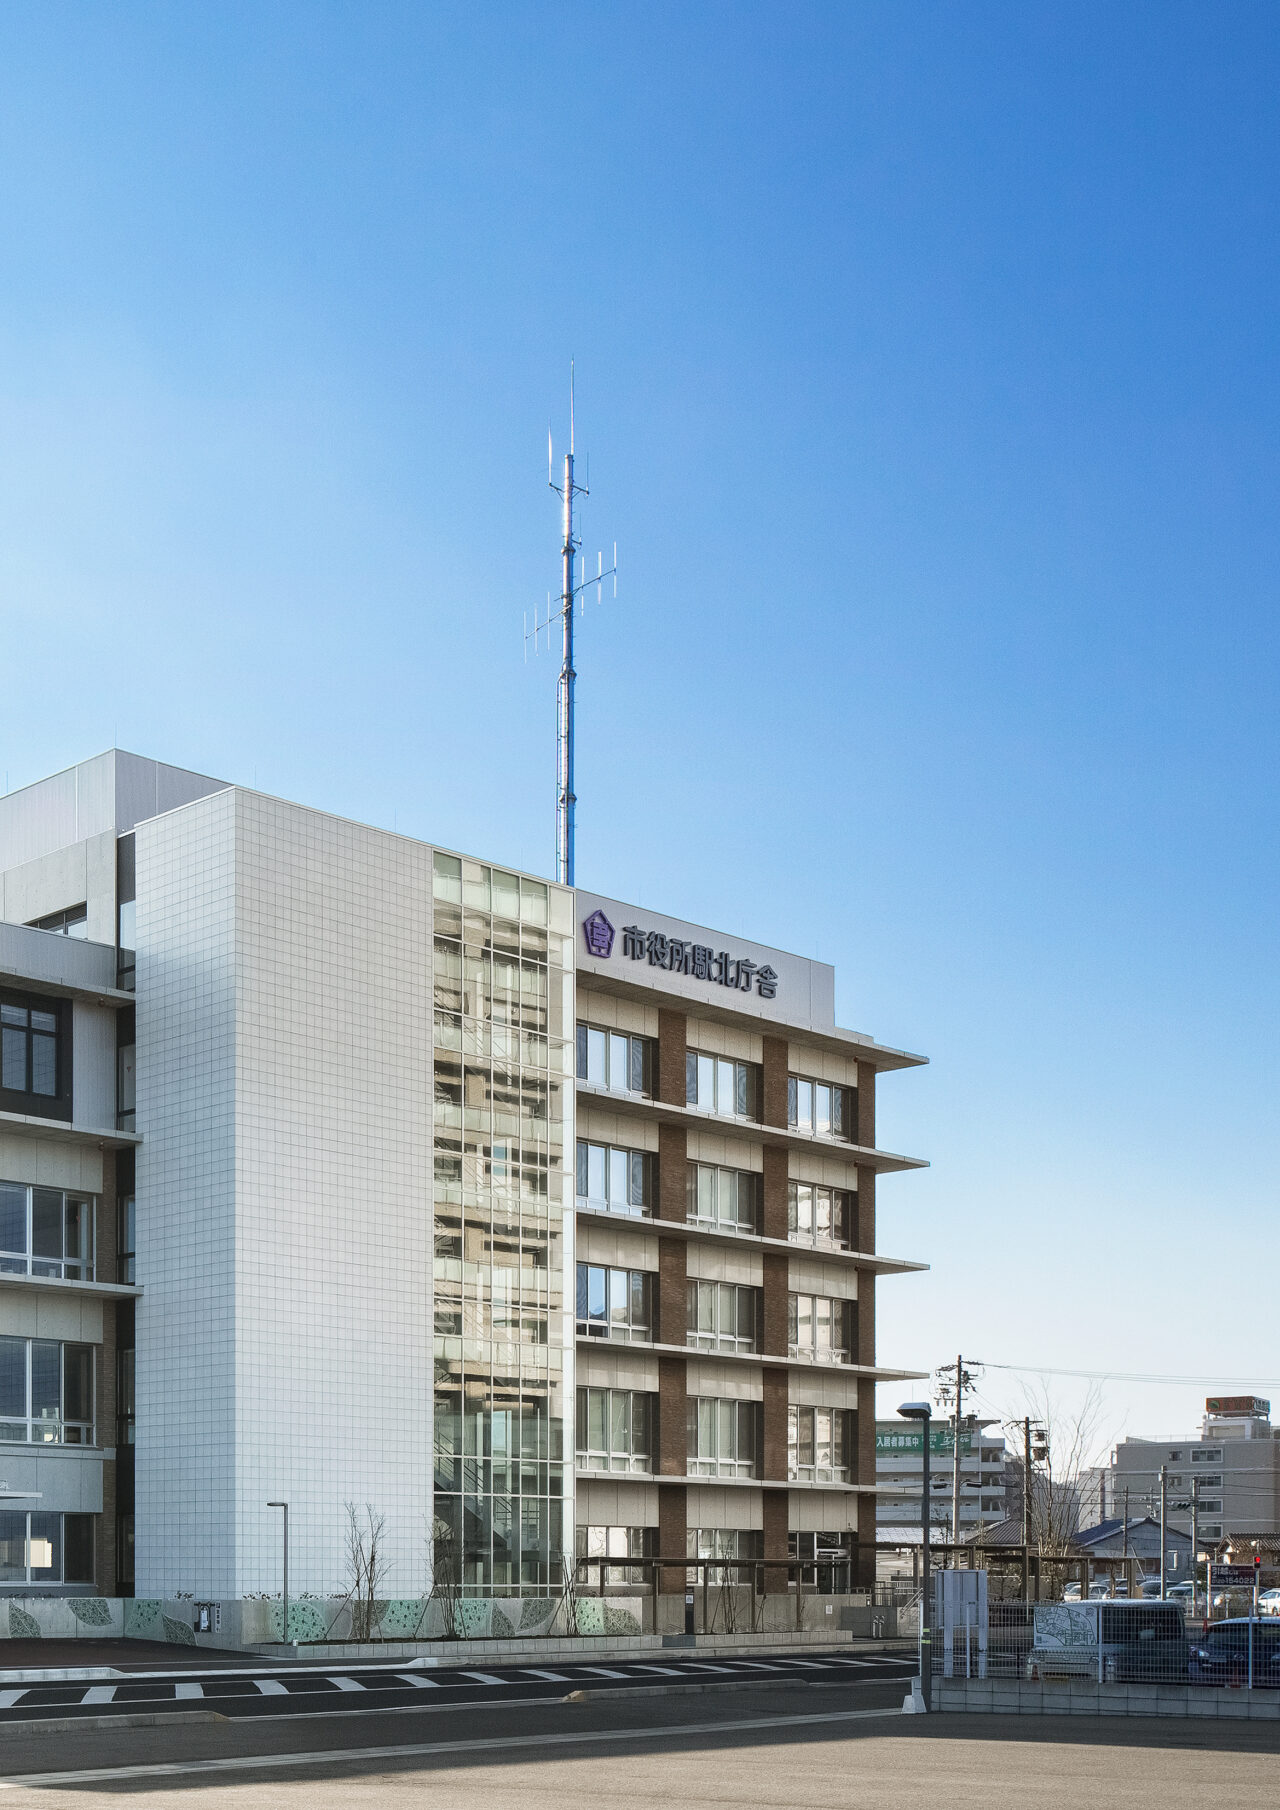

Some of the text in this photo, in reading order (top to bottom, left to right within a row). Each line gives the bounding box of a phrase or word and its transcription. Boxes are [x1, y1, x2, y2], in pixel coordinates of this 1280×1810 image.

[622, 925, 778, 999] 市役所駅北庁舎
[876, 1436, 919, 1448] 入居者募集中
